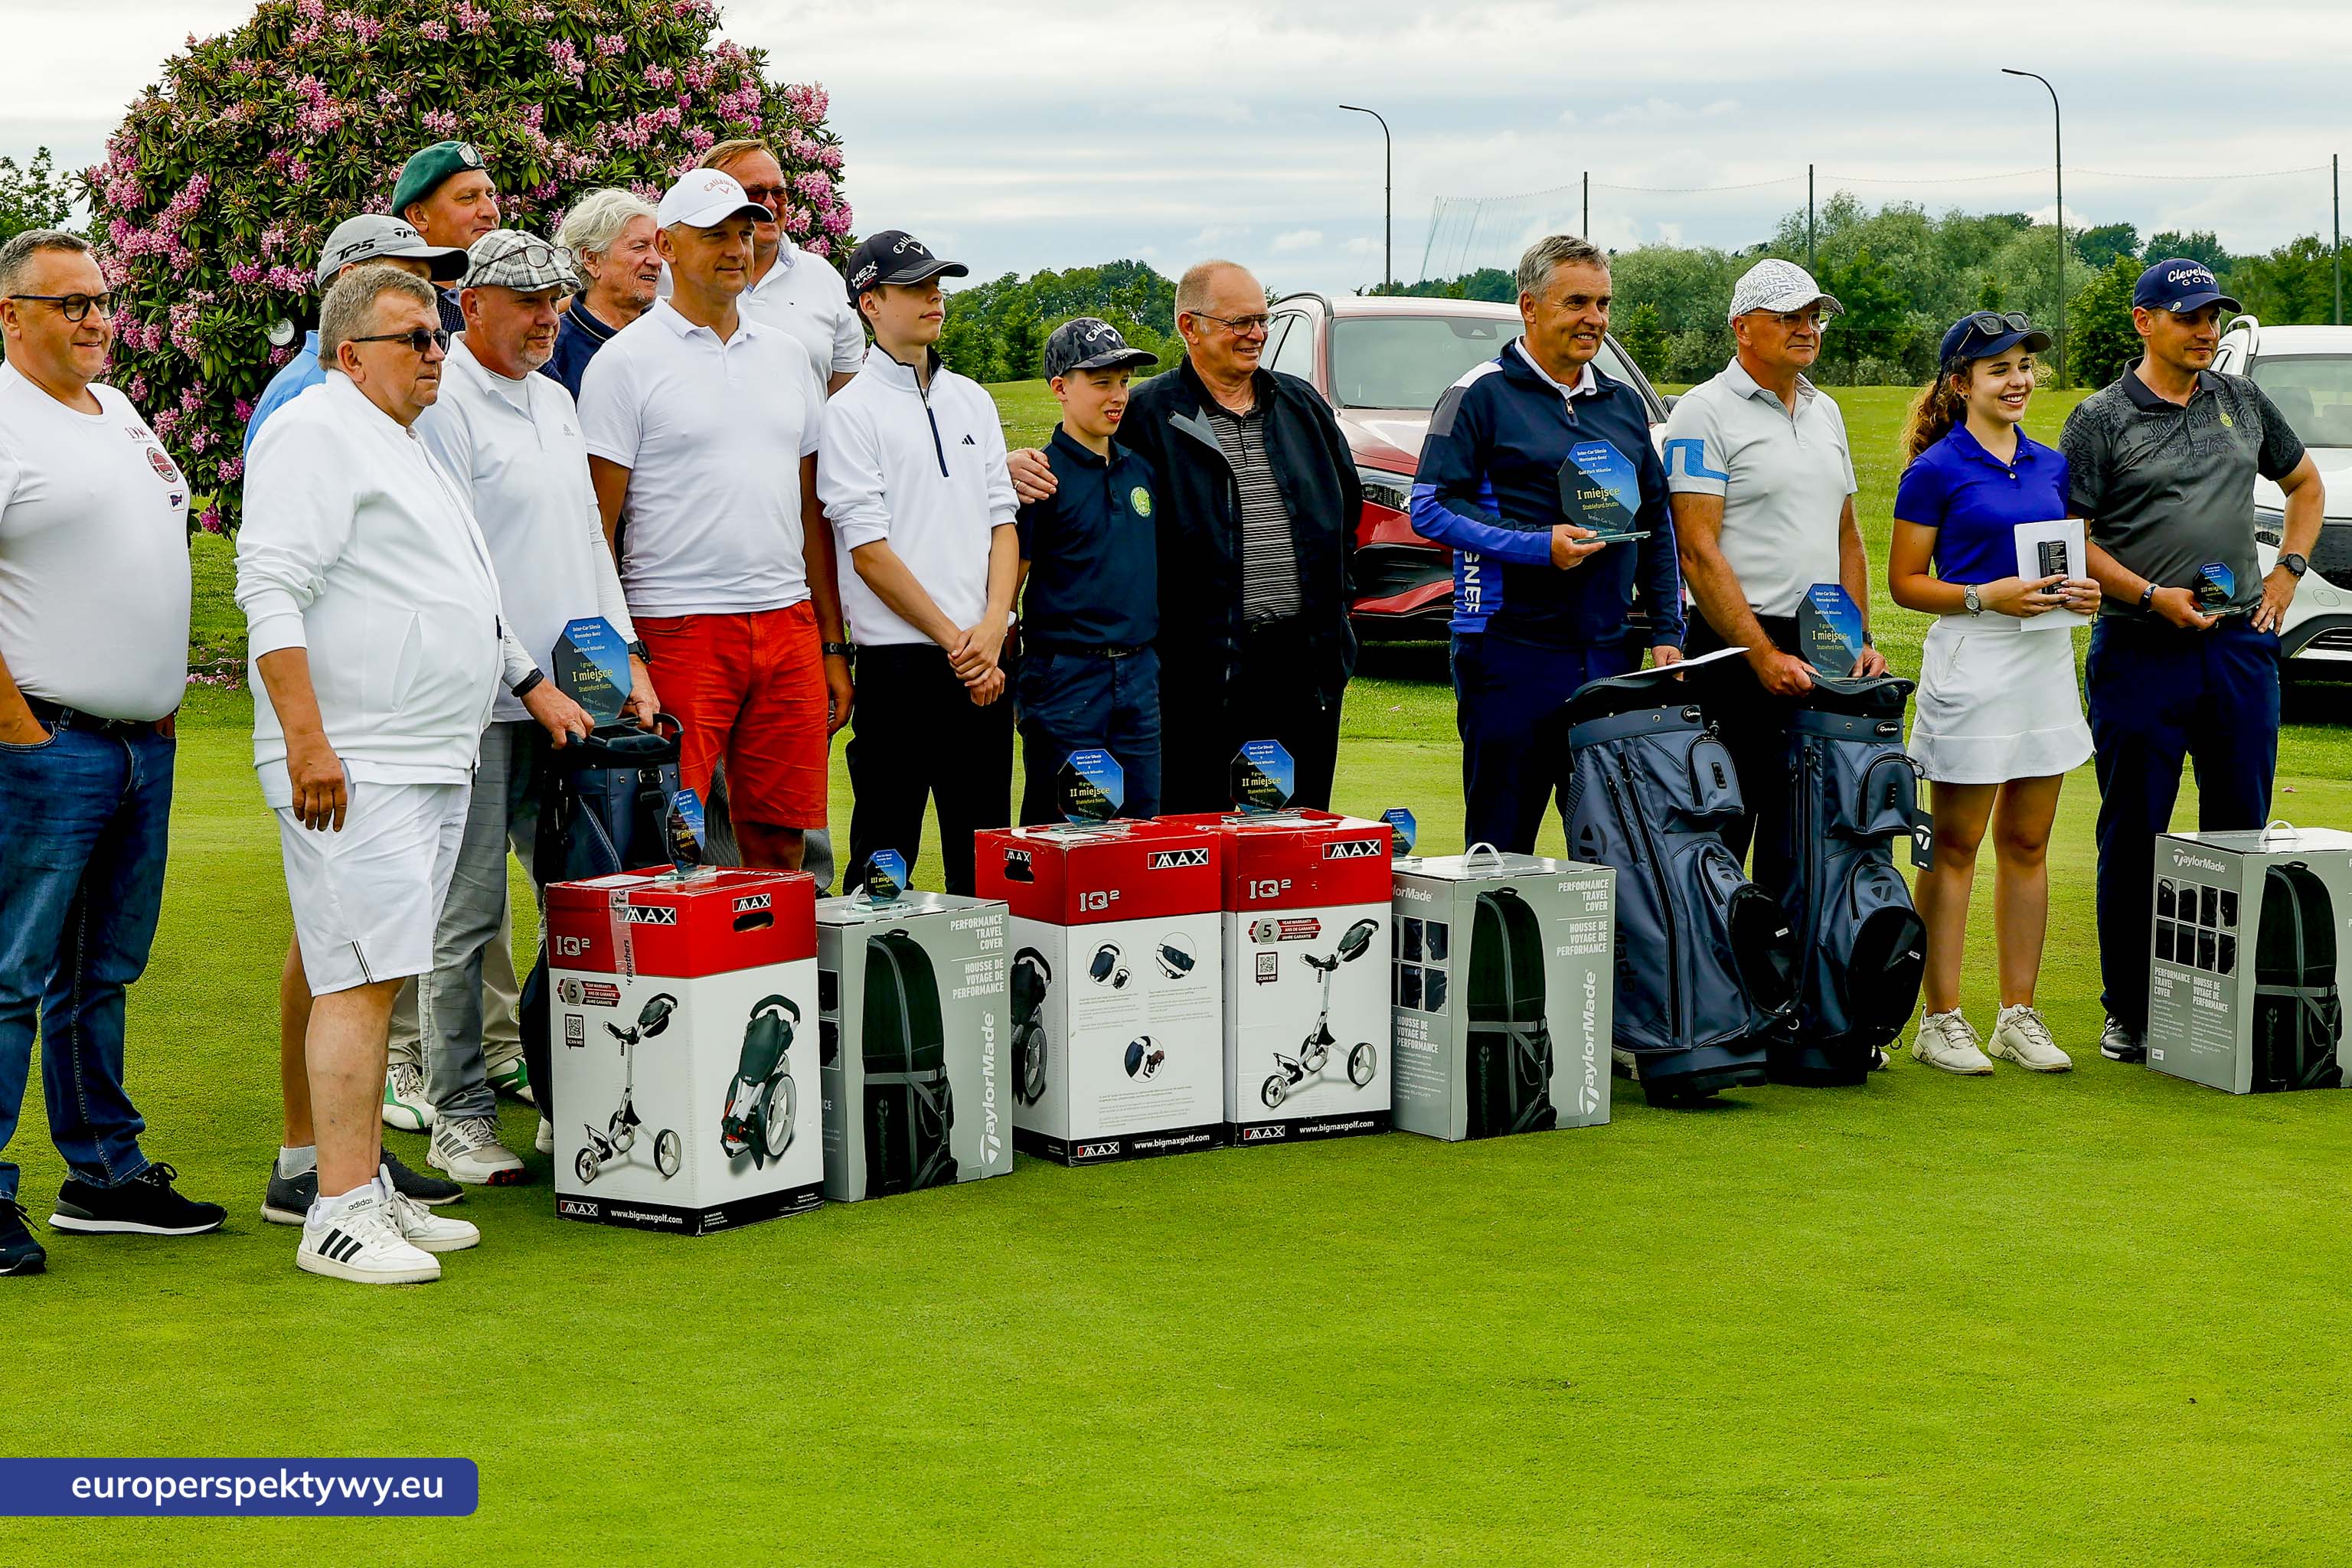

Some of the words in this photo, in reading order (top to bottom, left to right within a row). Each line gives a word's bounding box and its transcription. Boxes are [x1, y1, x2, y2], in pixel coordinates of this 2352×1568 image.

[704, 178, 738, 191] Callaway
[336, 238, 375, 262] TP5
[851, 260, 878, 286] HEX
[1576, 490, 1582, 500] I
[1583, 486, 1620, 499] miejsce
[1812, 631, 1816, 640] I
[1818, 630, 1847, 642] miejsce
[572, 671, 577, 682] I
[579, 668, 613, 682] miejsce
[1242, 778, 1250, 786] II
[1251, 777, 1281, 787] miejsce
[1079, 786, 1110, 797] miejsce
[1331, 841, 1380, 858] MAX
[1155, 849, 1207, 867] MAX
[2173, 848, 2226, 873] TaylorMade
[1558, 879, 1609, 892] PERFORMANCE
[1391, 884, 1432, 902] lorMade
[1582, 890, 1608, 900] TRAVEL
[738, 894, 769, 910] MAX
[1585, 900, 1608, 912] COVER
[950, 914, 1003, 931] PERFORMANCE
[1570, 922, 1596, 933] HOUSSE
[1599, 921, 1608, 931] DE
[975, 926, 1003, 939] TRAVEL
[1263, 924, 1272, 938] 5
[1570, 933, 1596, 944] VOYAGE
[1599, 932, 1607, 942] DE
[980, 937, 1003, 950] COVER
[1556, 942, 1607, 956] PERFORMANCE
[624, 939, 634, 977] Brothers
[965, 960, 992, 975] HOUSSE
[995, 959, 1004, 969] DE
[966, 972, 993, 985] VOYAGE
[995, 970, 1004, 981] DE
[2154, 967, 2190, 983] PERFORMANCE
[2154, 976, 2174, 988] TRAVEL
[952, 982, 1004, 999] PERFORMANCE
[2193, 976, 2213, 989] HOUSSE
[2213, 982, 2220, 991] DE
[570, 984, 577, 998] 5
[2154, 986, 2171, 998] COVER
[2193, 986, 2212, 998] VOYAGE
[2213, 991, 2220, 1000] DE
[2193, 995, 2229, 1013] PERFORMANCE
[1396, 1016, 1419, 1029] HOUSSE
[1420, 1021, 1428, 1030] DE
[1396, 1027, 1419, 1039] VOYAGE
[1420, 1031, 1428, 1041] DE
[1396, 1037, 1438, 1054] PERFORMANCE
[1579, 970, 1600, 1115] TaylorMade
[979, 1011, 1001, 1165] TaylorMade
[1250, 1126, 1285, 1138] MAX
[1299, 1120, 1374, 1133] www.bigmaxgolf.com
[1135, 1134, 1210, 1149] www.bigmaxgolf.com
[1083, 1142, 1119, 1157] MAX
[348, 1197, 373, 1210] adidas
[565, 1203, 597, 1215] MAX
[611, 1210, 683, 1223] www.bigmaxgolf.com
